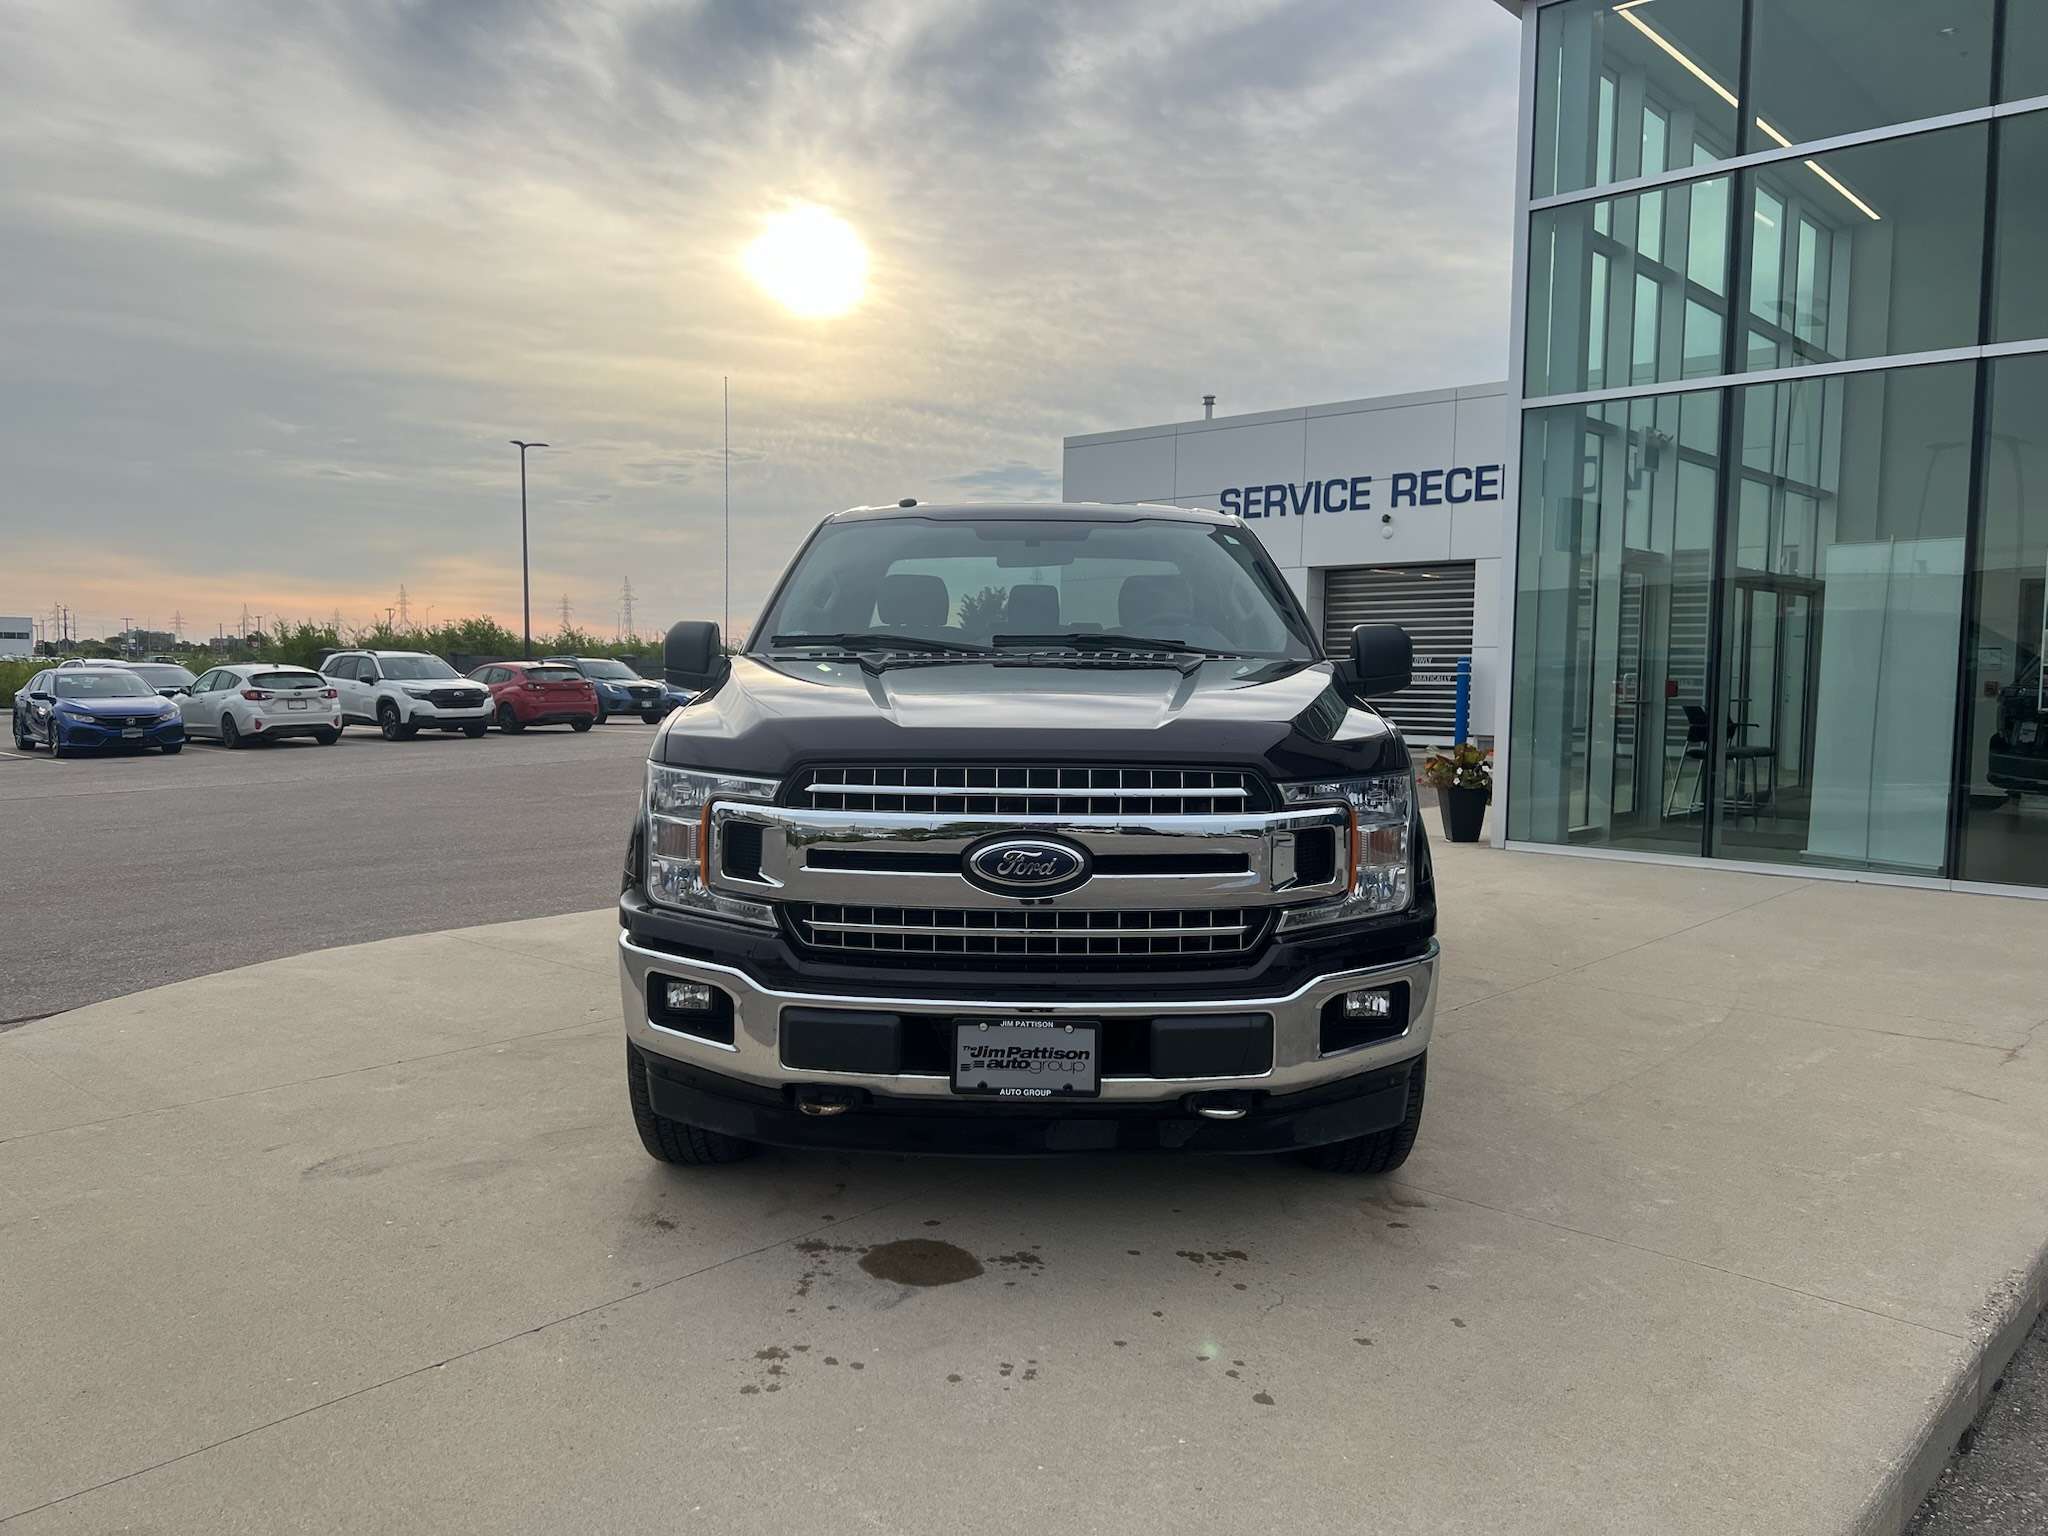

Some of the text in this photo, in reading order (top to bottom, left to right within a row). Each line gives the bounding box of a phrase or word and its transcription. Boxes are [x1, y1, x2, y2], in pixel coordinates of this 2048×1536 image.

[1219, 464, 1505, 519] SERVICE RECE
[997, 850, 1057, 875] Ford
[1015, 1020, 1054, 1028] PATTISON
[1000, 1088, 1052, 1096] AUTO GROUP
